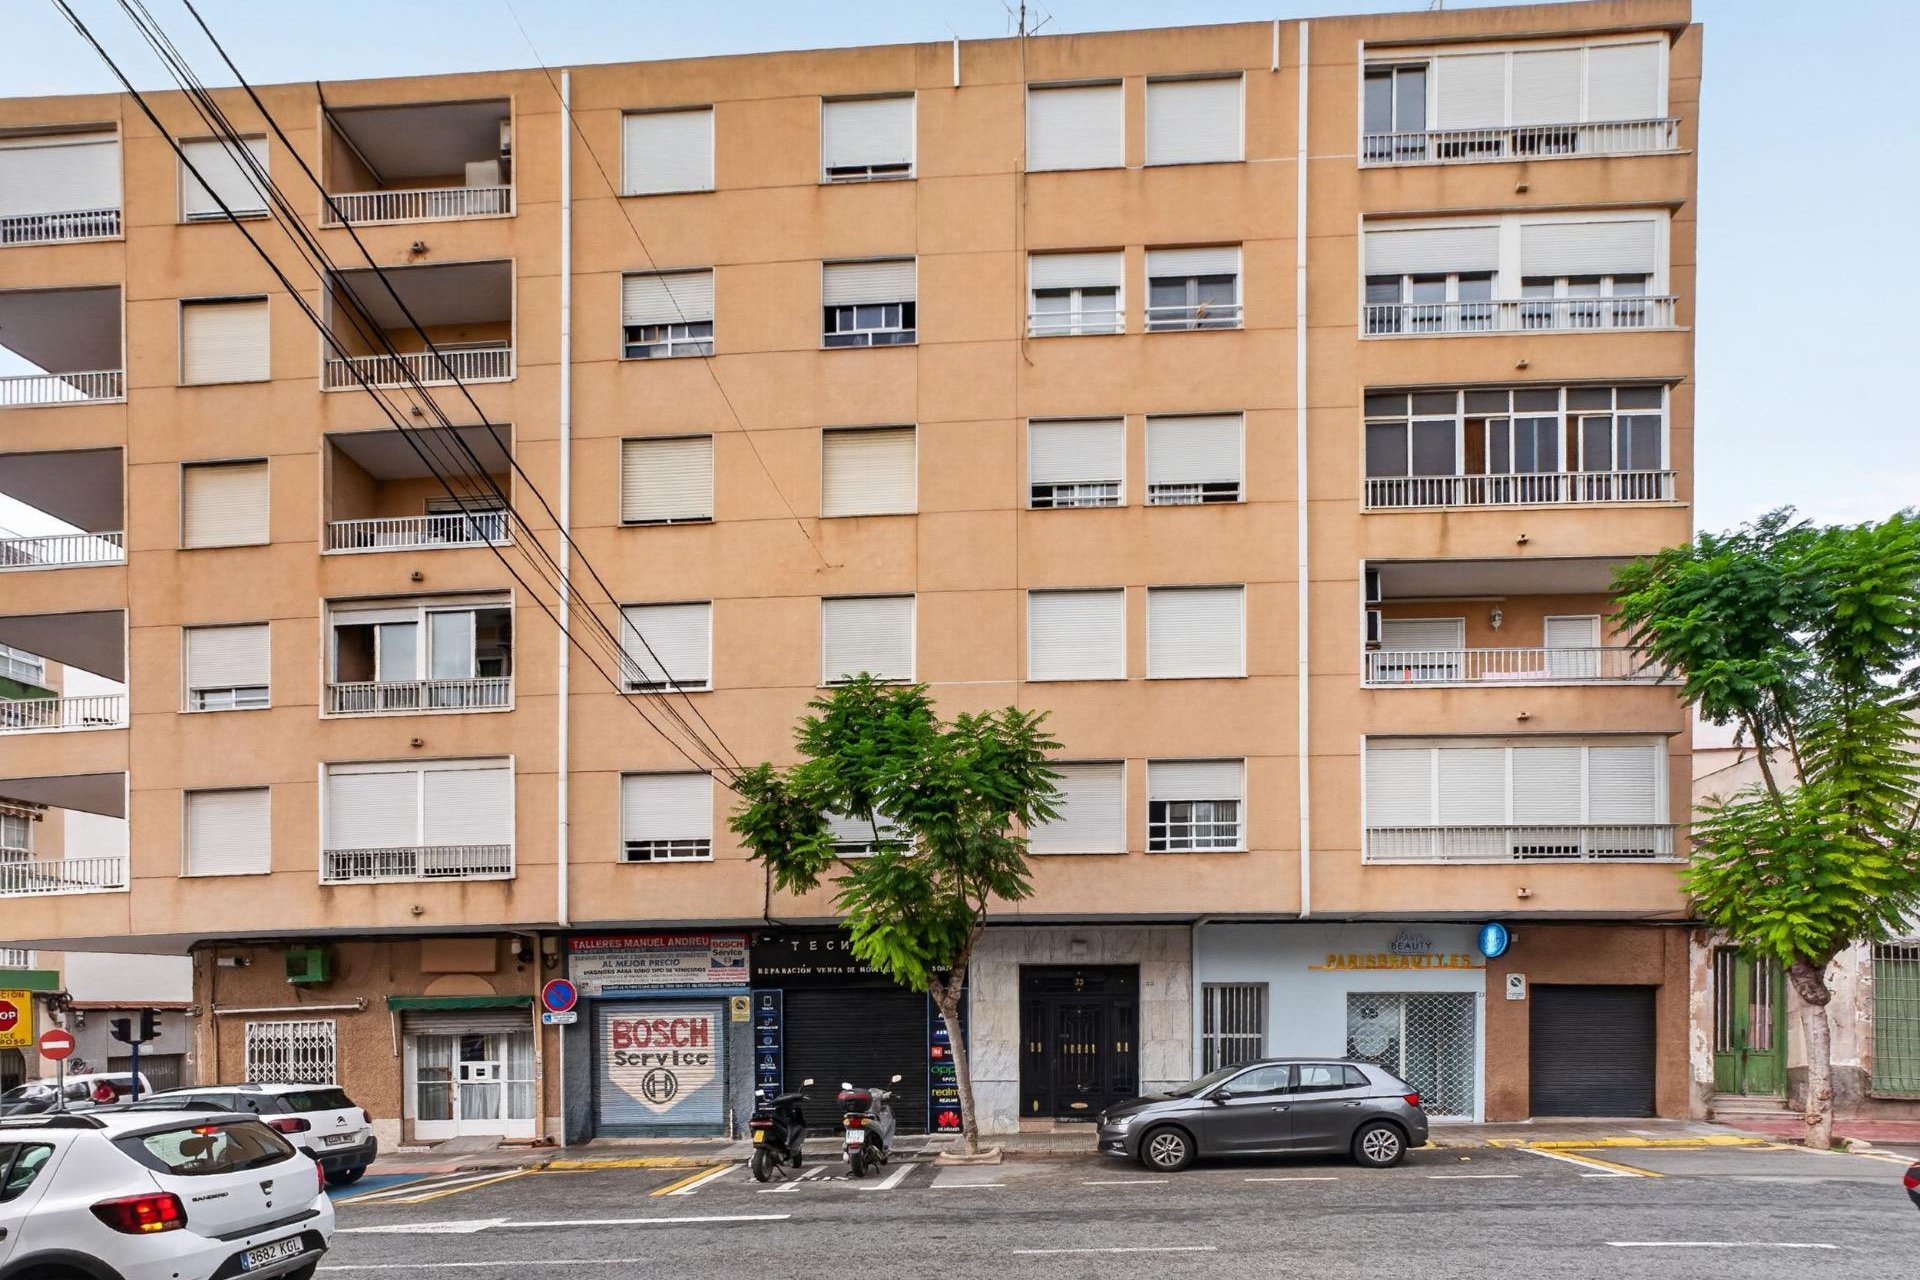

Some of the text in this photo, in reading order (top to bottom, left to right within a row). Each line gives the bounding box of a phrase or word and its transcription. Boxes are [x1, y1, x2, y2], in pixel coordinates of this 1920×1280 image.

[573, 937, 709, 949] TALLERES MANUEL ANDREU
[711, 940, 744, 949] BOSCH
[1390, 940, 1432, 950] BEAUTY
[602, 958, 680, 968] AL MEJOR PRECIO
[816, 966, 844, 974] VENTA
[612, 1018, 708, 1049] BOSCH
[614, 1050, 708, 1066] Service
[932, 1088, 959, 1097] realm
[249, 1239, 301, 1265] 3682 KGL
